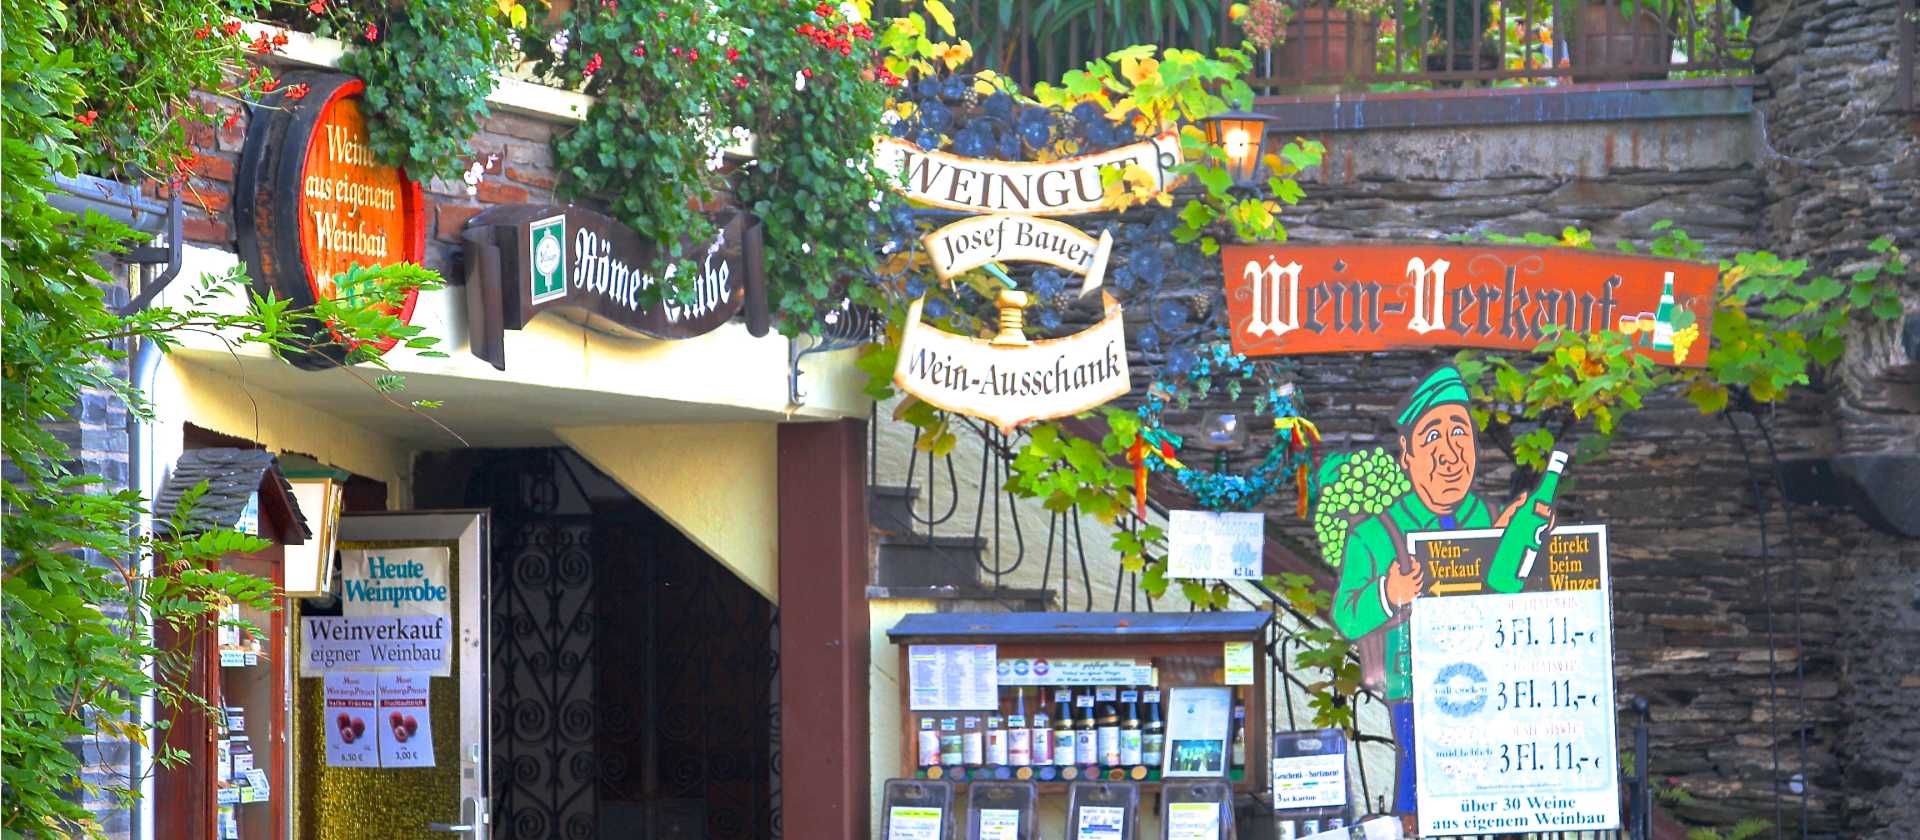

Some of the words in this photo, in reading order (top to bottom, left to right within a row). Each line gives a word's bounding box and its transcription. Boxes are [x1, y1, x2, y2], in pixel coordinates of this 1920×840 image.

[902, 151, 1139, 209] WEINGUT
[305, 175, 332, 201] aus
[335, 174, 396, 217] eigenem
[314, 210, 388, 258] Weinbau
[943, 216, 1009, 270] Josef
[1015, 221, 1096, 267] Bauer
[1243, 255, 1623, 342] Wein-Verkauf
[907, 340, 1121, 396] Wein-Ausschank
[1427, 541, 1470, 558] Wein-
[1550, 535, 1590, 555] direkt
[368, 556, 424, 579] Heute
[1427, 558, 1482, 578] Verkauf
[1550, 556, 1583, 573] beim
[344, 578, 447, 608] Weinprobe
[1550, 574, 1600, 591] Winzer
[310, 617, 443, 641] Weinverkauf
[1494, 618, 1506, 649] 3
[1511, 616, 1539, 646] Fl.
[310, 645, 360, 668] eigner
[370, 643, 441, 662] Weinbau
[1497, 681, 1508, 711] 3
[1514, 679, 1542, 709] Fl.
[1500, 743, 1510, 774] 3
[1515, 742, 1544, 771] Fl.
[1461, 798, 1498, 813] über
[1502, 797, 1521, 811] 30
[1527, 795, 1576, 810] Weine
[1433, 819, 1458, 830] aus
[1464, 815, 1529, 831] eigenem
[1535, 812, 1606, 825] Weinbau
